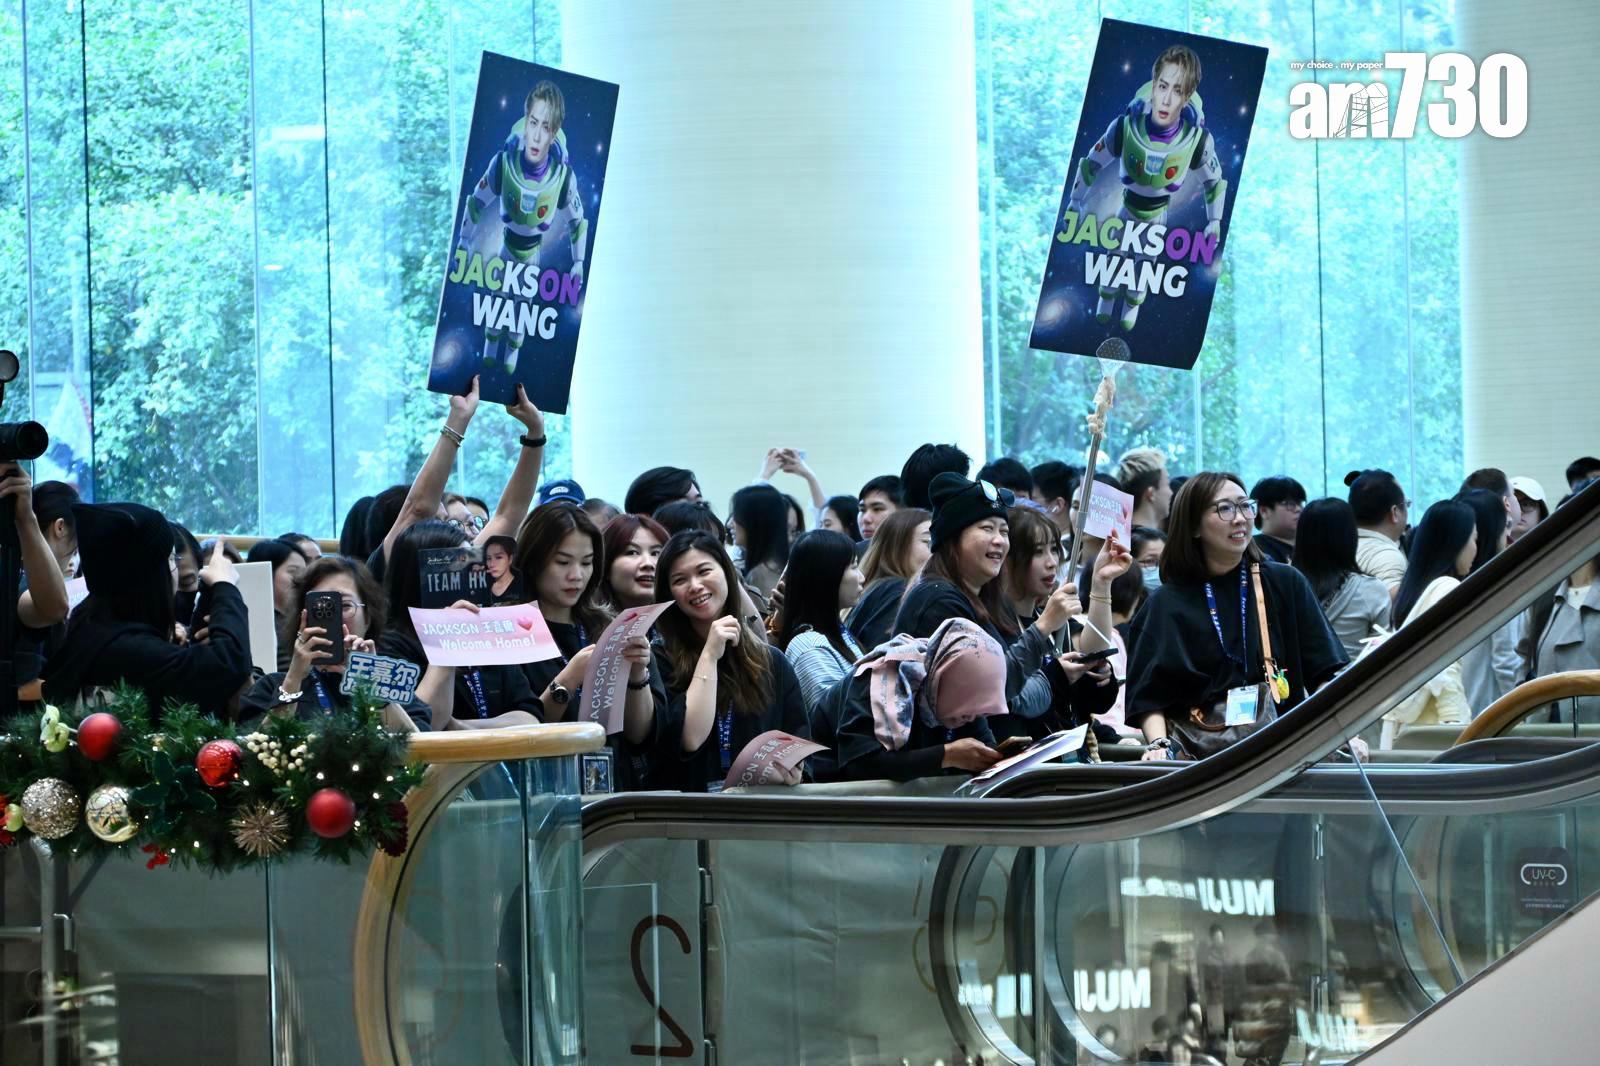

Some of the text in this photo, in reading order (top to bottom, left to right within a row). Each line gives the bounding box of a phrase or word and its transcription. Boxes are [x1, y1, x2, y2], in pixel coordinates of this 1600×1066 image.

[1056, 210, 1218, 265] JACKSON
[449, 248, 581, 306] JACKSON
[1084, 251, 1189, 298] WANG
[472, 292, 558, 340] WANG
[427, 570, 488, 592] TEAM HK
[422, 622, 480, 636] JACKSON
[439, 633, 537, 651] Welcome Home!
[348, 656, 417, 687] 王嘉尔
[343, 677, 411, 702] Json
[590, 656, 611, 721] ACKSON
[1532, 869, 1556, 880] UV-C
